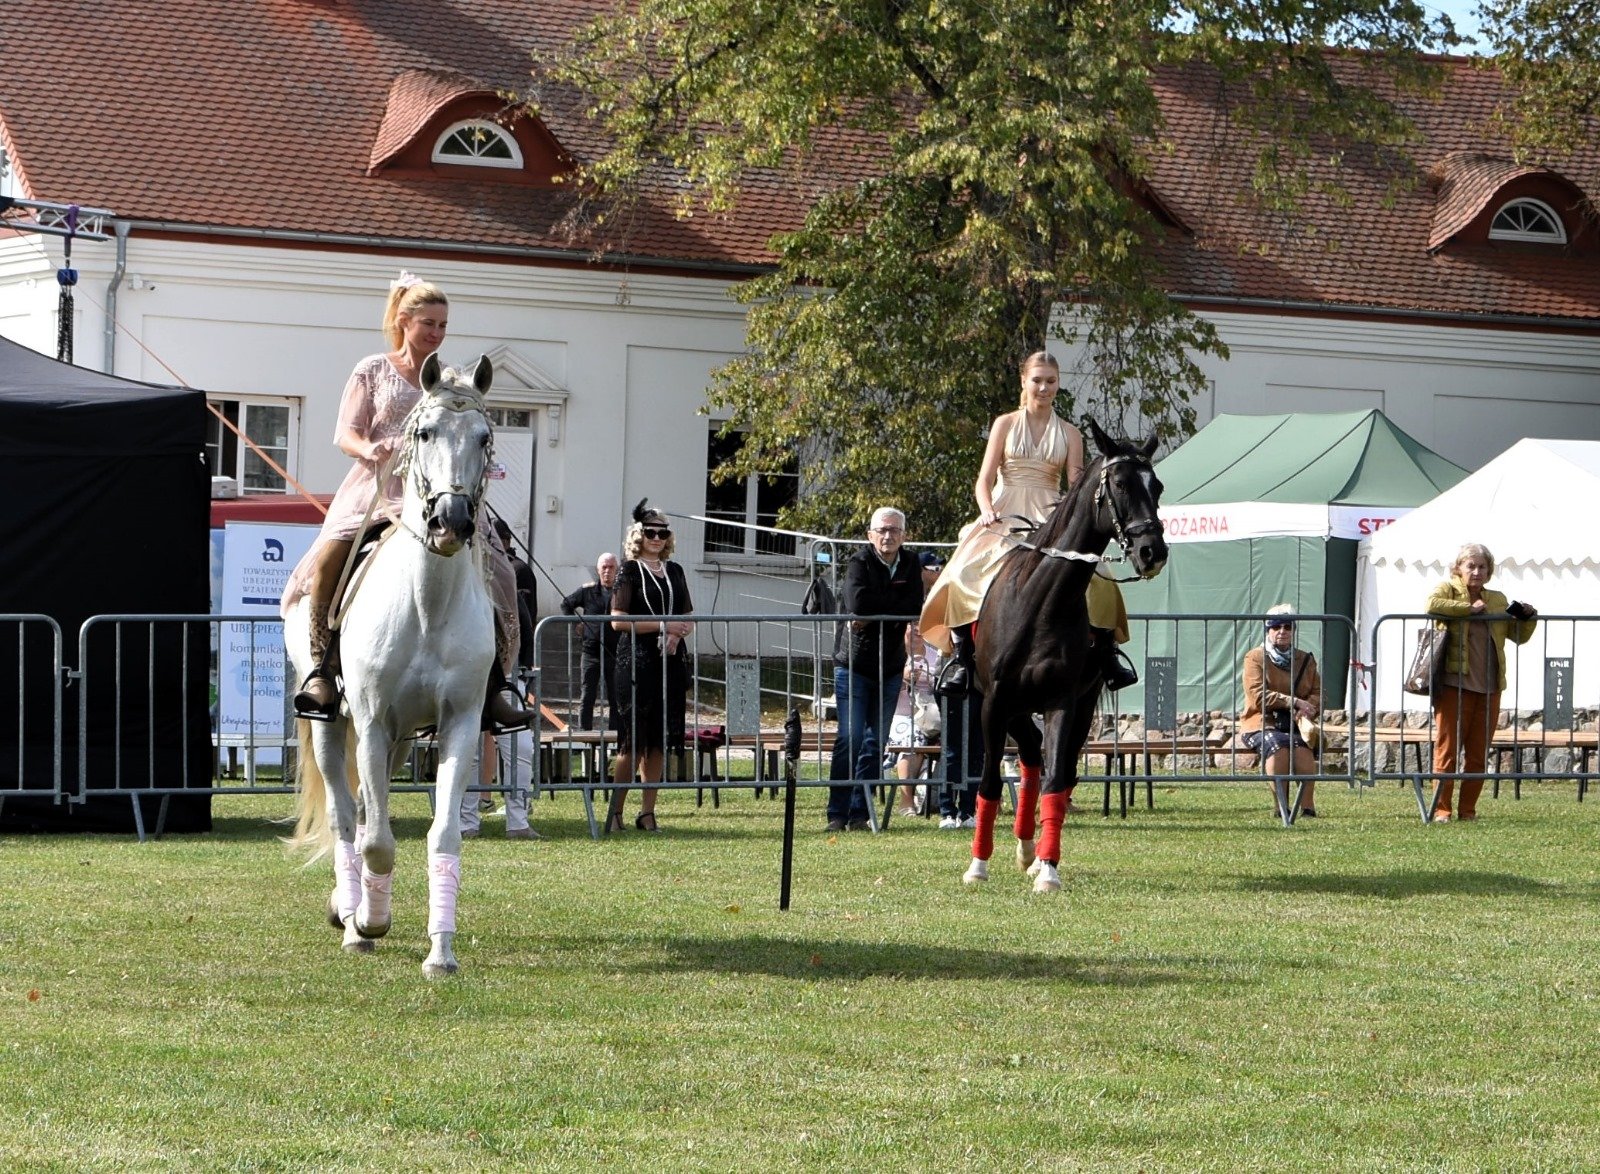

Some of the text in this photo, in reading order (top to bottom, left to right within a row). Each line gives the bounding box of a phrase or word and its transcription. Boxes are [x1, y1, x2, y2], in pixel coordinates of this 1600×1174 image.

[1160, 513, 1229, 536] POŻARNA
[1358, 517, 1396, 535] ST
[241, 658, 284, 670] majątko
